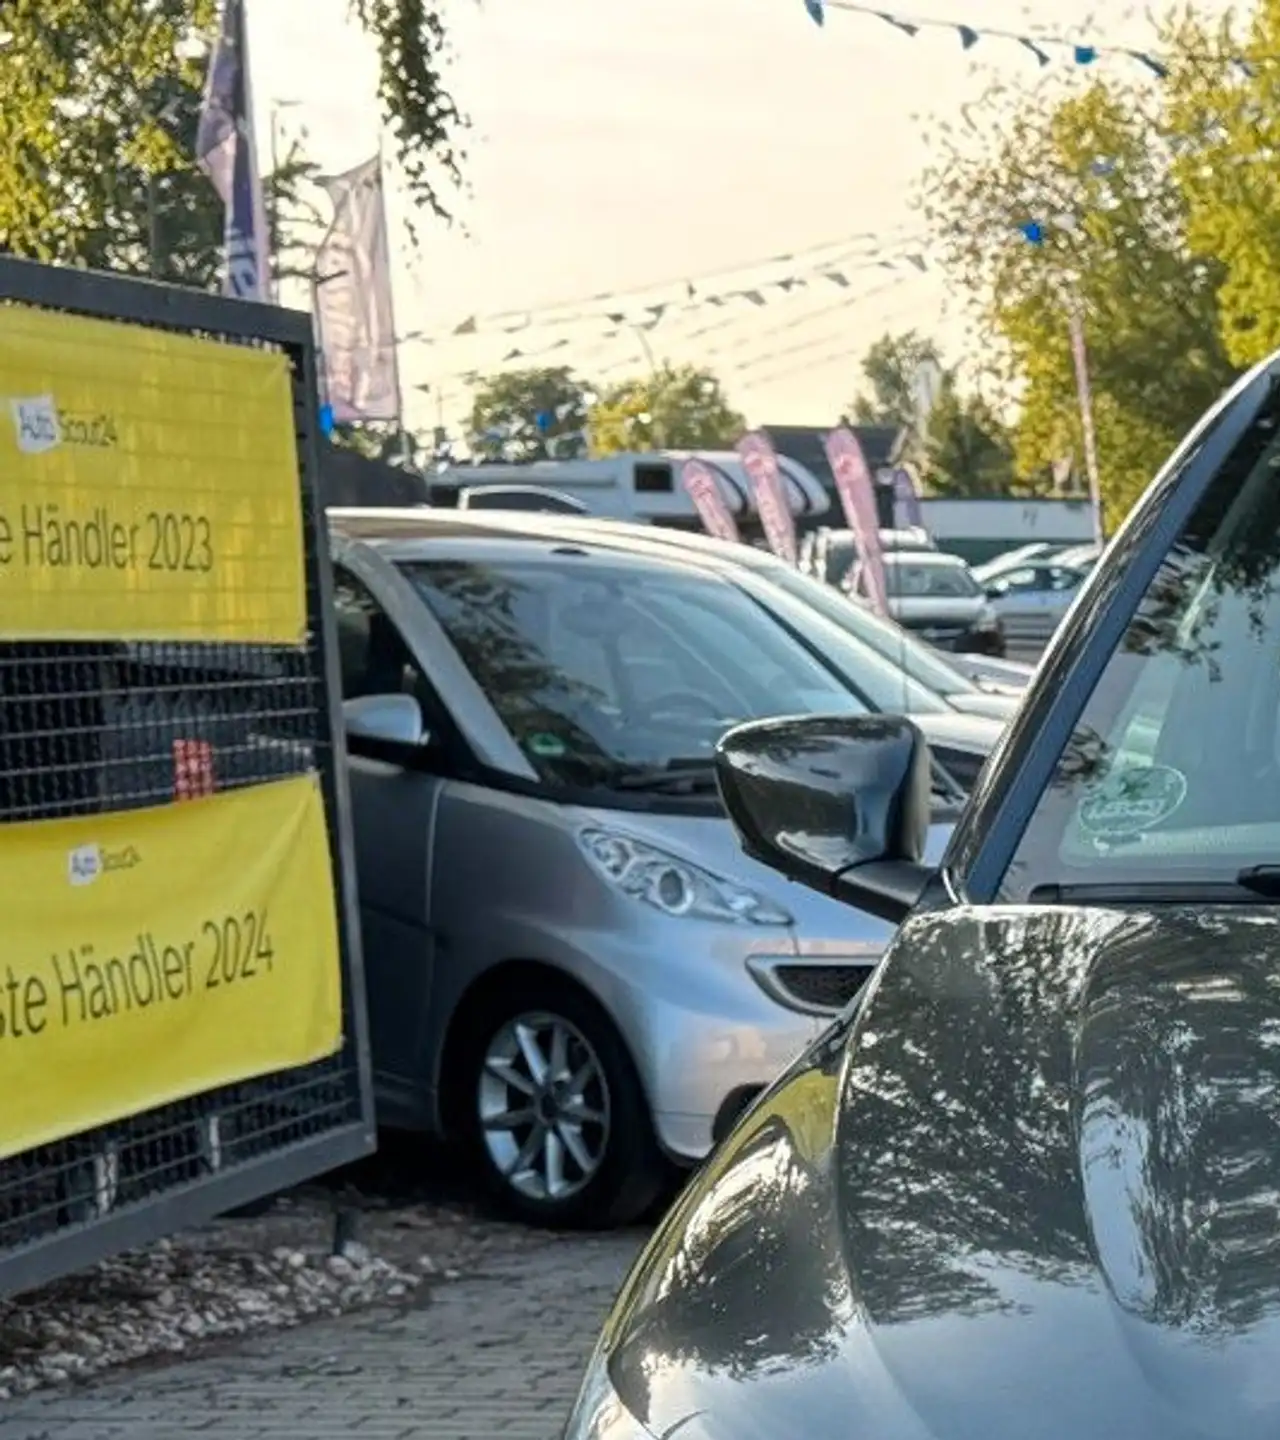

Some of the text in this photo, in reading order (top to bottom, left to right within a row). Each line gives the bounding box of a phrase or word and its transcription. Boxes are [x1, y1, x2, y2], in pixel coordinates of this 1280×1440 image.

[21, 503, 140, 569] Händler
[147, 511, 214, 573] 2023
[0, 908, 274, 1038] te Händler 2024
